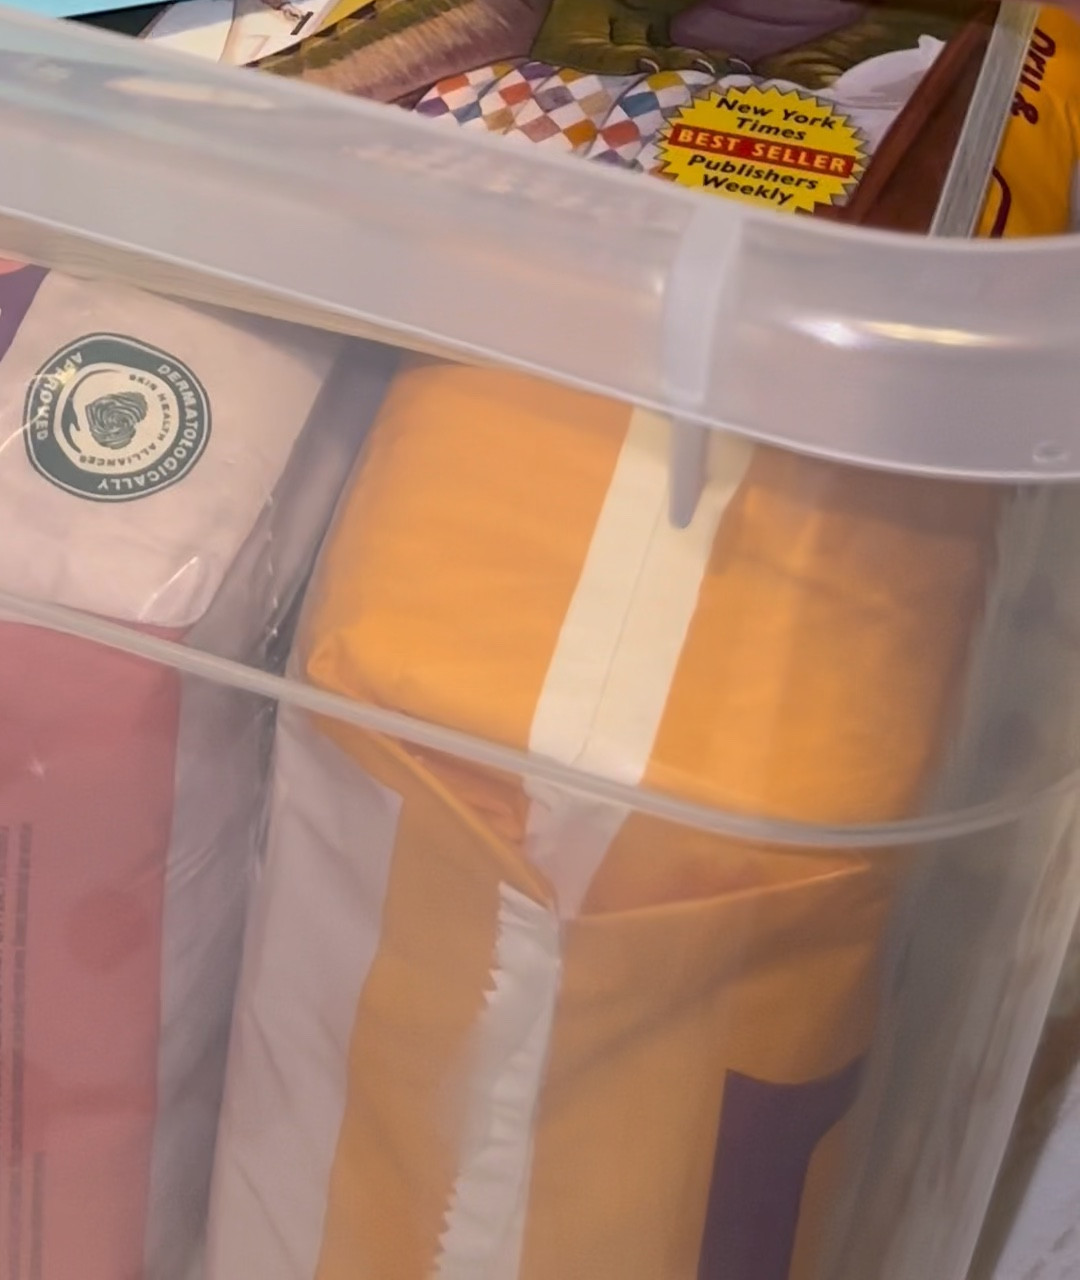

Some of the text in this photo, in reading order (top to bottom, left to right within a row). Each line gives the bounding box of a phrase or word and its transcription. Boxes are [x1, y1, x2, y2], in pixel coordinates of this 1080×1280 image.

[715, 96, 837, 130] New York
[735, 116, 807, 141] Times
[678, 128, 846, 173] BEST SELLER
[687, 153, 819, 191] Publishers
[702, 174, 795, 207] Weekly
[35, 350, 199, 491] DERMATOLOGICALLY APPROVED
[128, 373, 159, 392] SKIN
[156, 392, 172, 442] HEALTH
